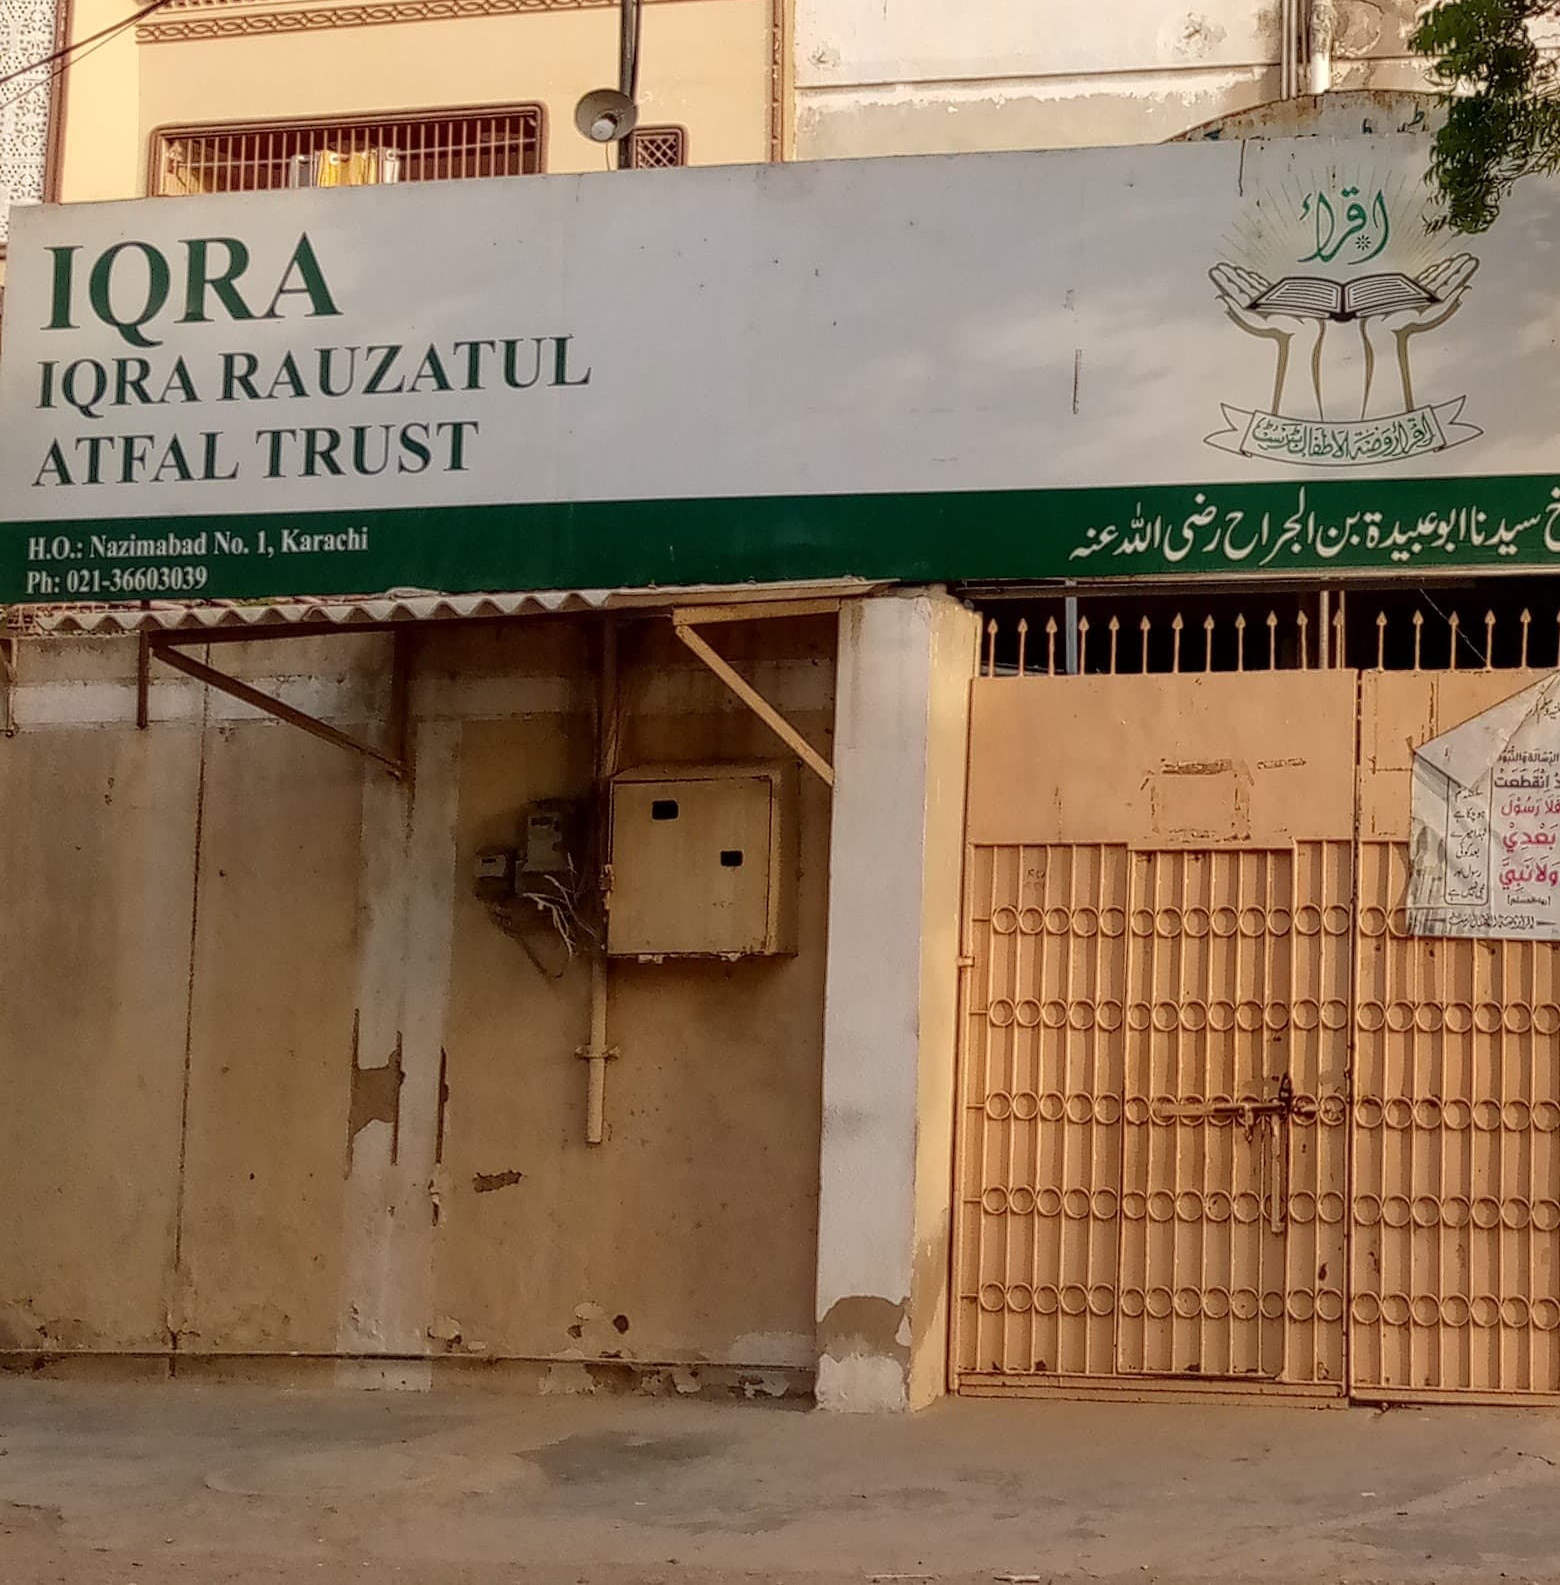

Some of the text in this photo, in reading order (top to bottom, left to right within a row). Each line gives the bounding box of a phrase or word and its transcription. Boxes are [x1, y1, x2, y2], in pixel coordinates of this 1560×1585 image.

[40, 232, 343, 348] IQRA
[36, 334, 592, 418] IQRA RAUZATUL
[31, 421, 479, 487] ATFAL TRUST
[28, 526, 368, 560] H.O.: Nazimabad No. 1, Karachi
[1223, 486, 1315, 566] الجراح
[26, 566, 208, 594] Ph: 021-36603039
